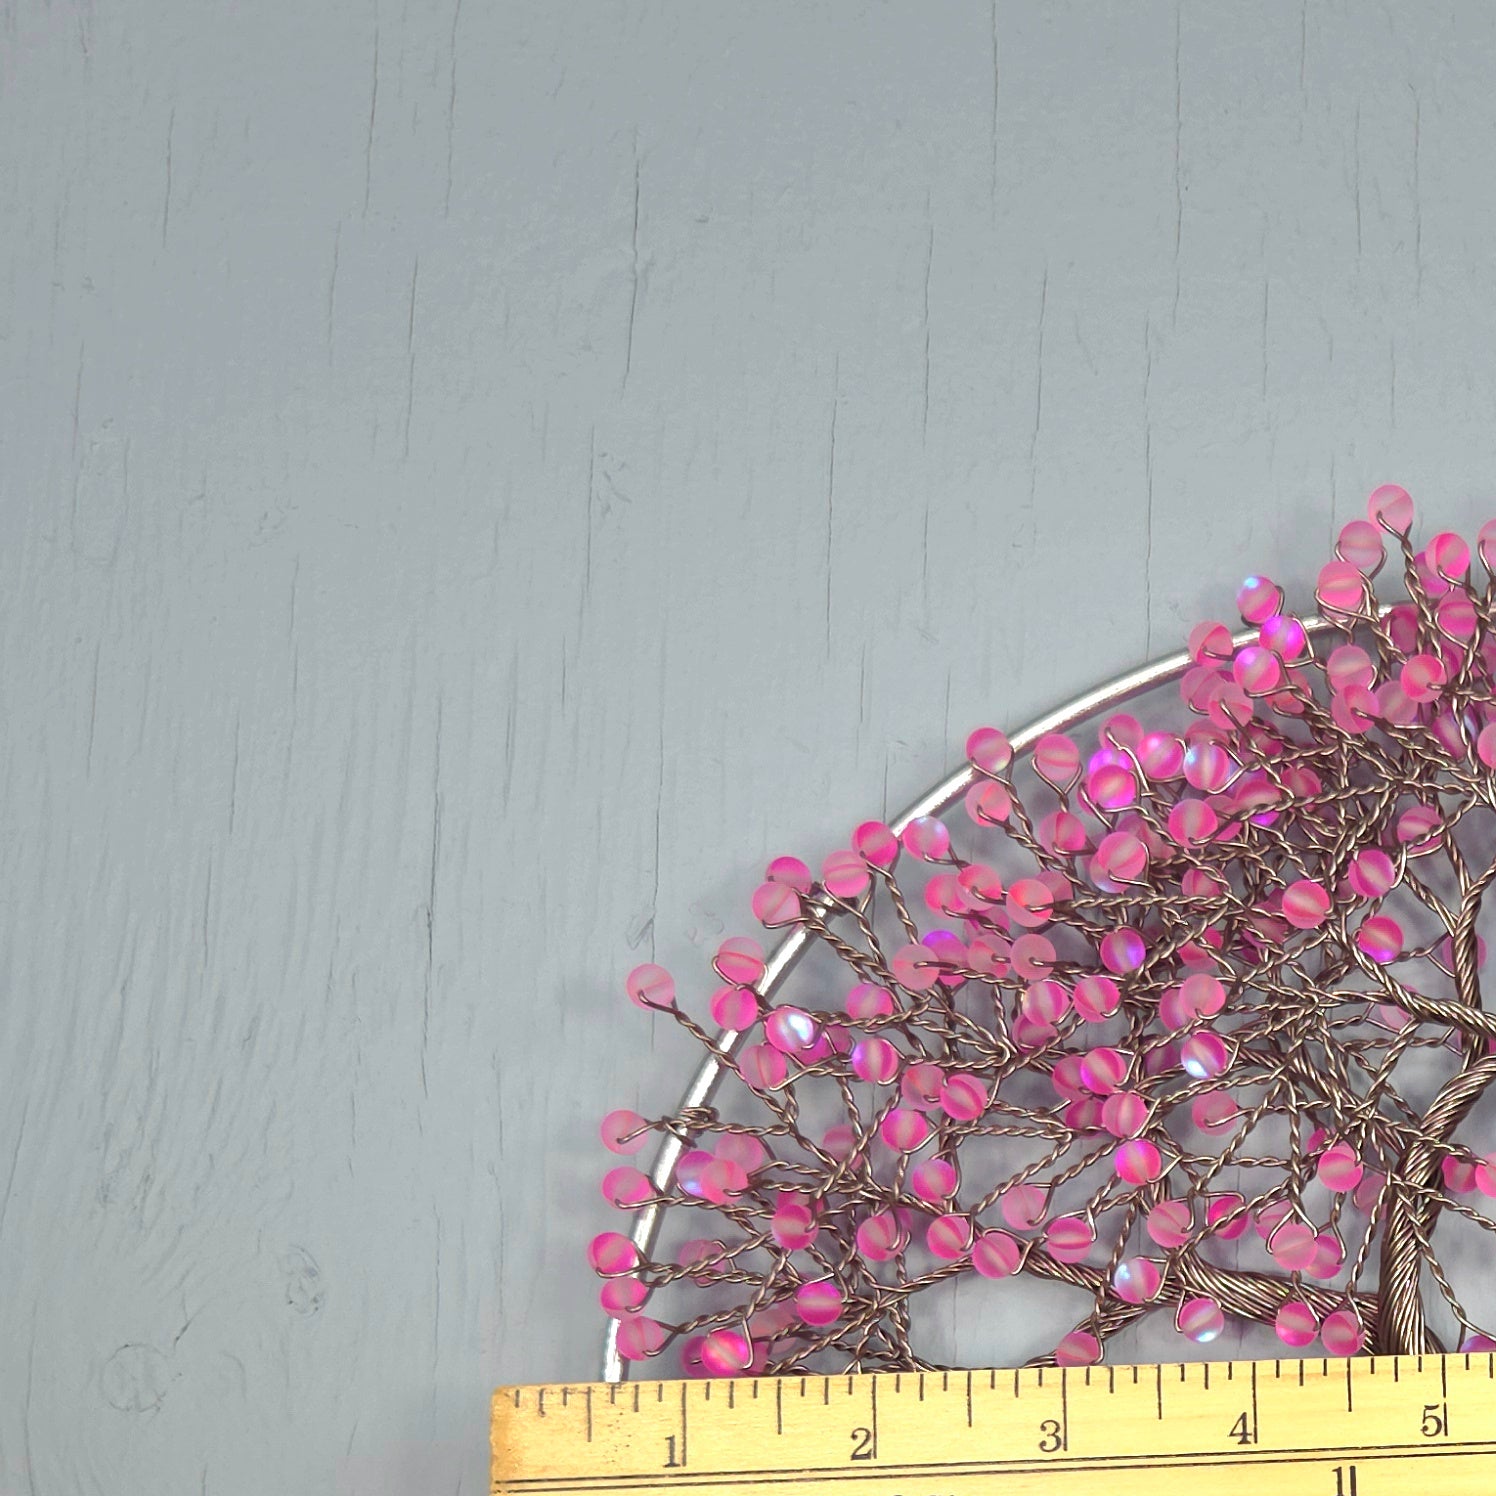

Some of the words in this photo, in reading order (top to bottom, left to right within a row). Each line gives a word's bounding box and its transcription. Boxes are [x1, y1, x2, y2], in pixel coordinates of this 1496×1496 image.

[664, 1435, 680, 1467] 1
[850, 1428, 873, 1460] 2
[1039, 1420, 1062, 1452] 3
[1228, 1412, 1252, 1444] 4
[1421, 1404, 1443, 1437] 5
